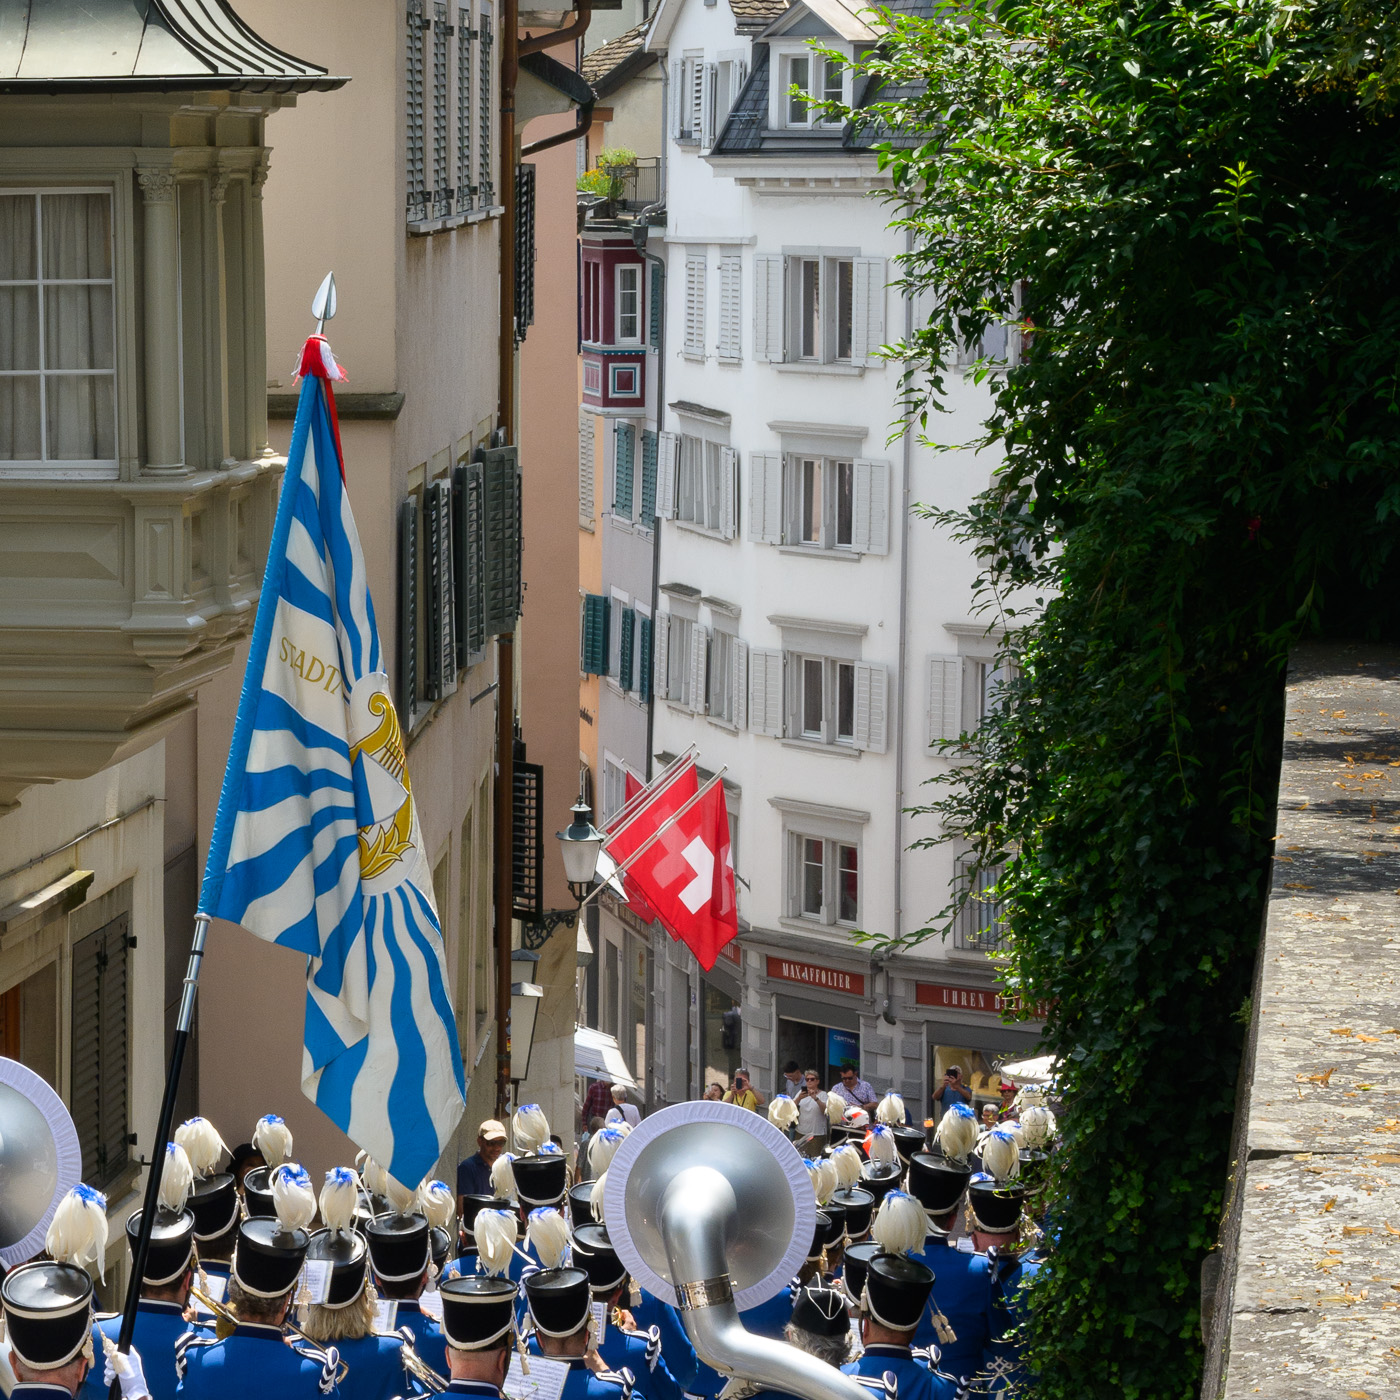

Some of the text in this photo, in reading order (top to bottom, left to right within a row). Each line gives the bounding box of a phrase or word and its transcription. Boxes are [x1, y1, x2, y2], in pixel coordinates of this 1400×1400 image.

[782, 962, 851, 989] MAX AFFOLTER
[943, 989, 985, 1008] UHREN
